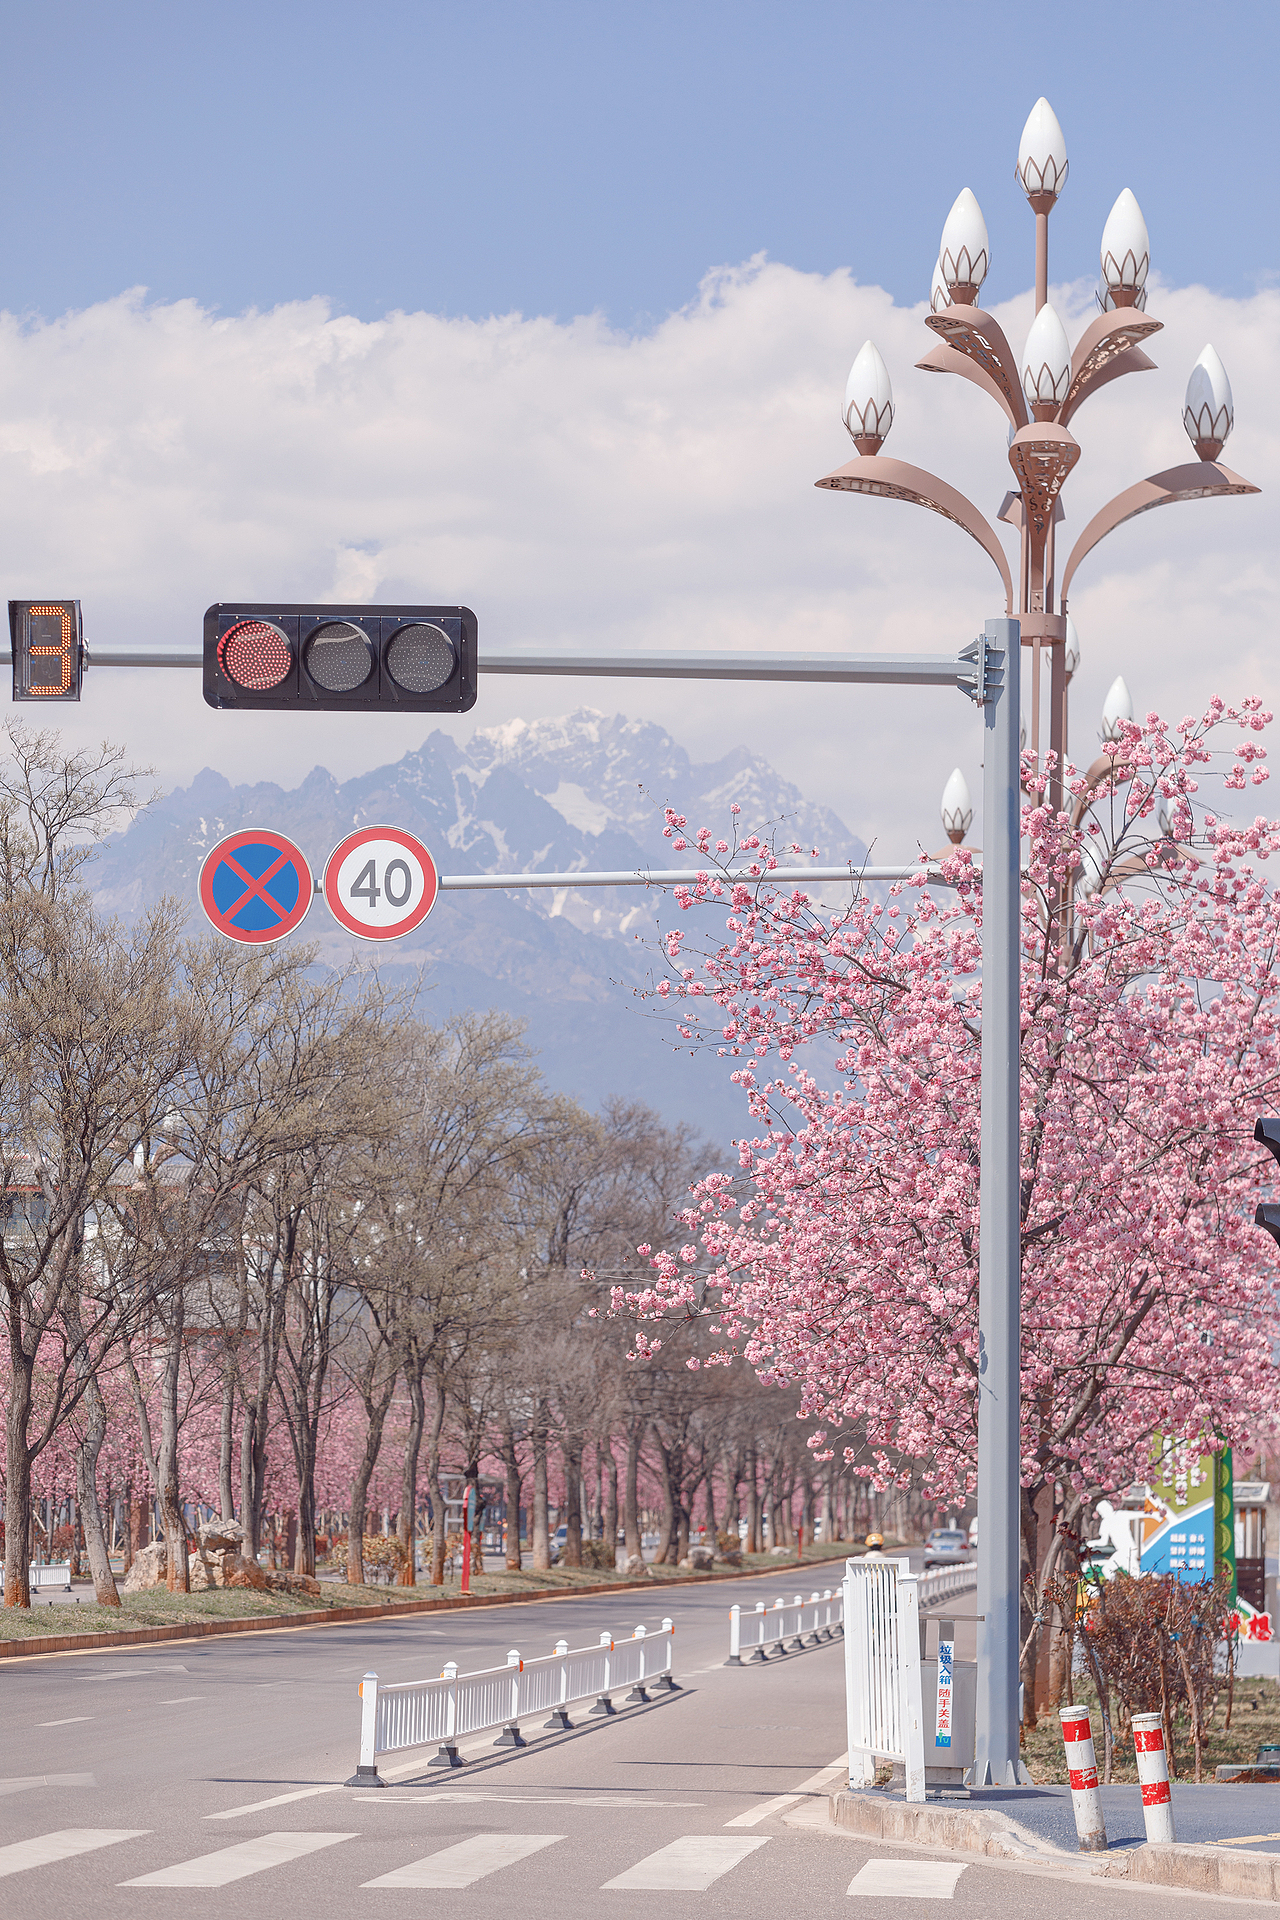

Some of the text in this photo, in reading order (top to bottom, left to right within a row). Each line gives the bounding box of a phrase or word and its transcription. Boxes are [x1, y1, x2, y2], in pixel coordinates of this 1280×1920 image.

[29, 606, 71, 695] 3
[350, 858, 412, 908] 40
[938, 1645, 952, 1729] 垃圾入箱 随手关盖
